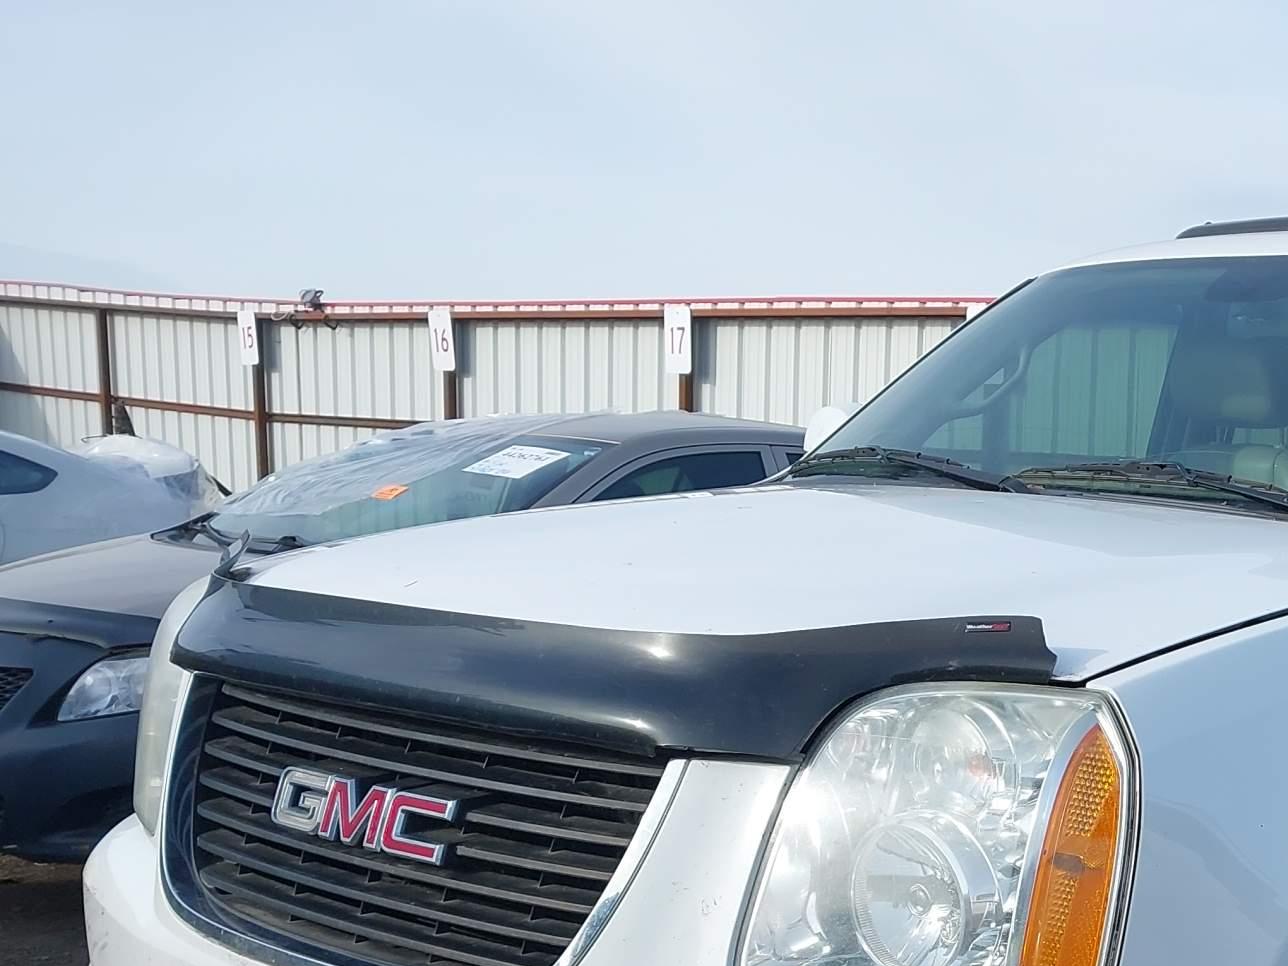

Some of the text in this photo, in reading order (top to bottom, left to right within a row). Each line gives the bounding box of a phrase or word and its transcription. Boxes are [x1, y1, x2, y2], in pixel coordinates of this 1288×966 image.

[241, 325, 254, 349] 15
[433, 327, 449, 353] 16
[669, 326, 686, 355] 17
[271, 765, 460, 866] GMC
